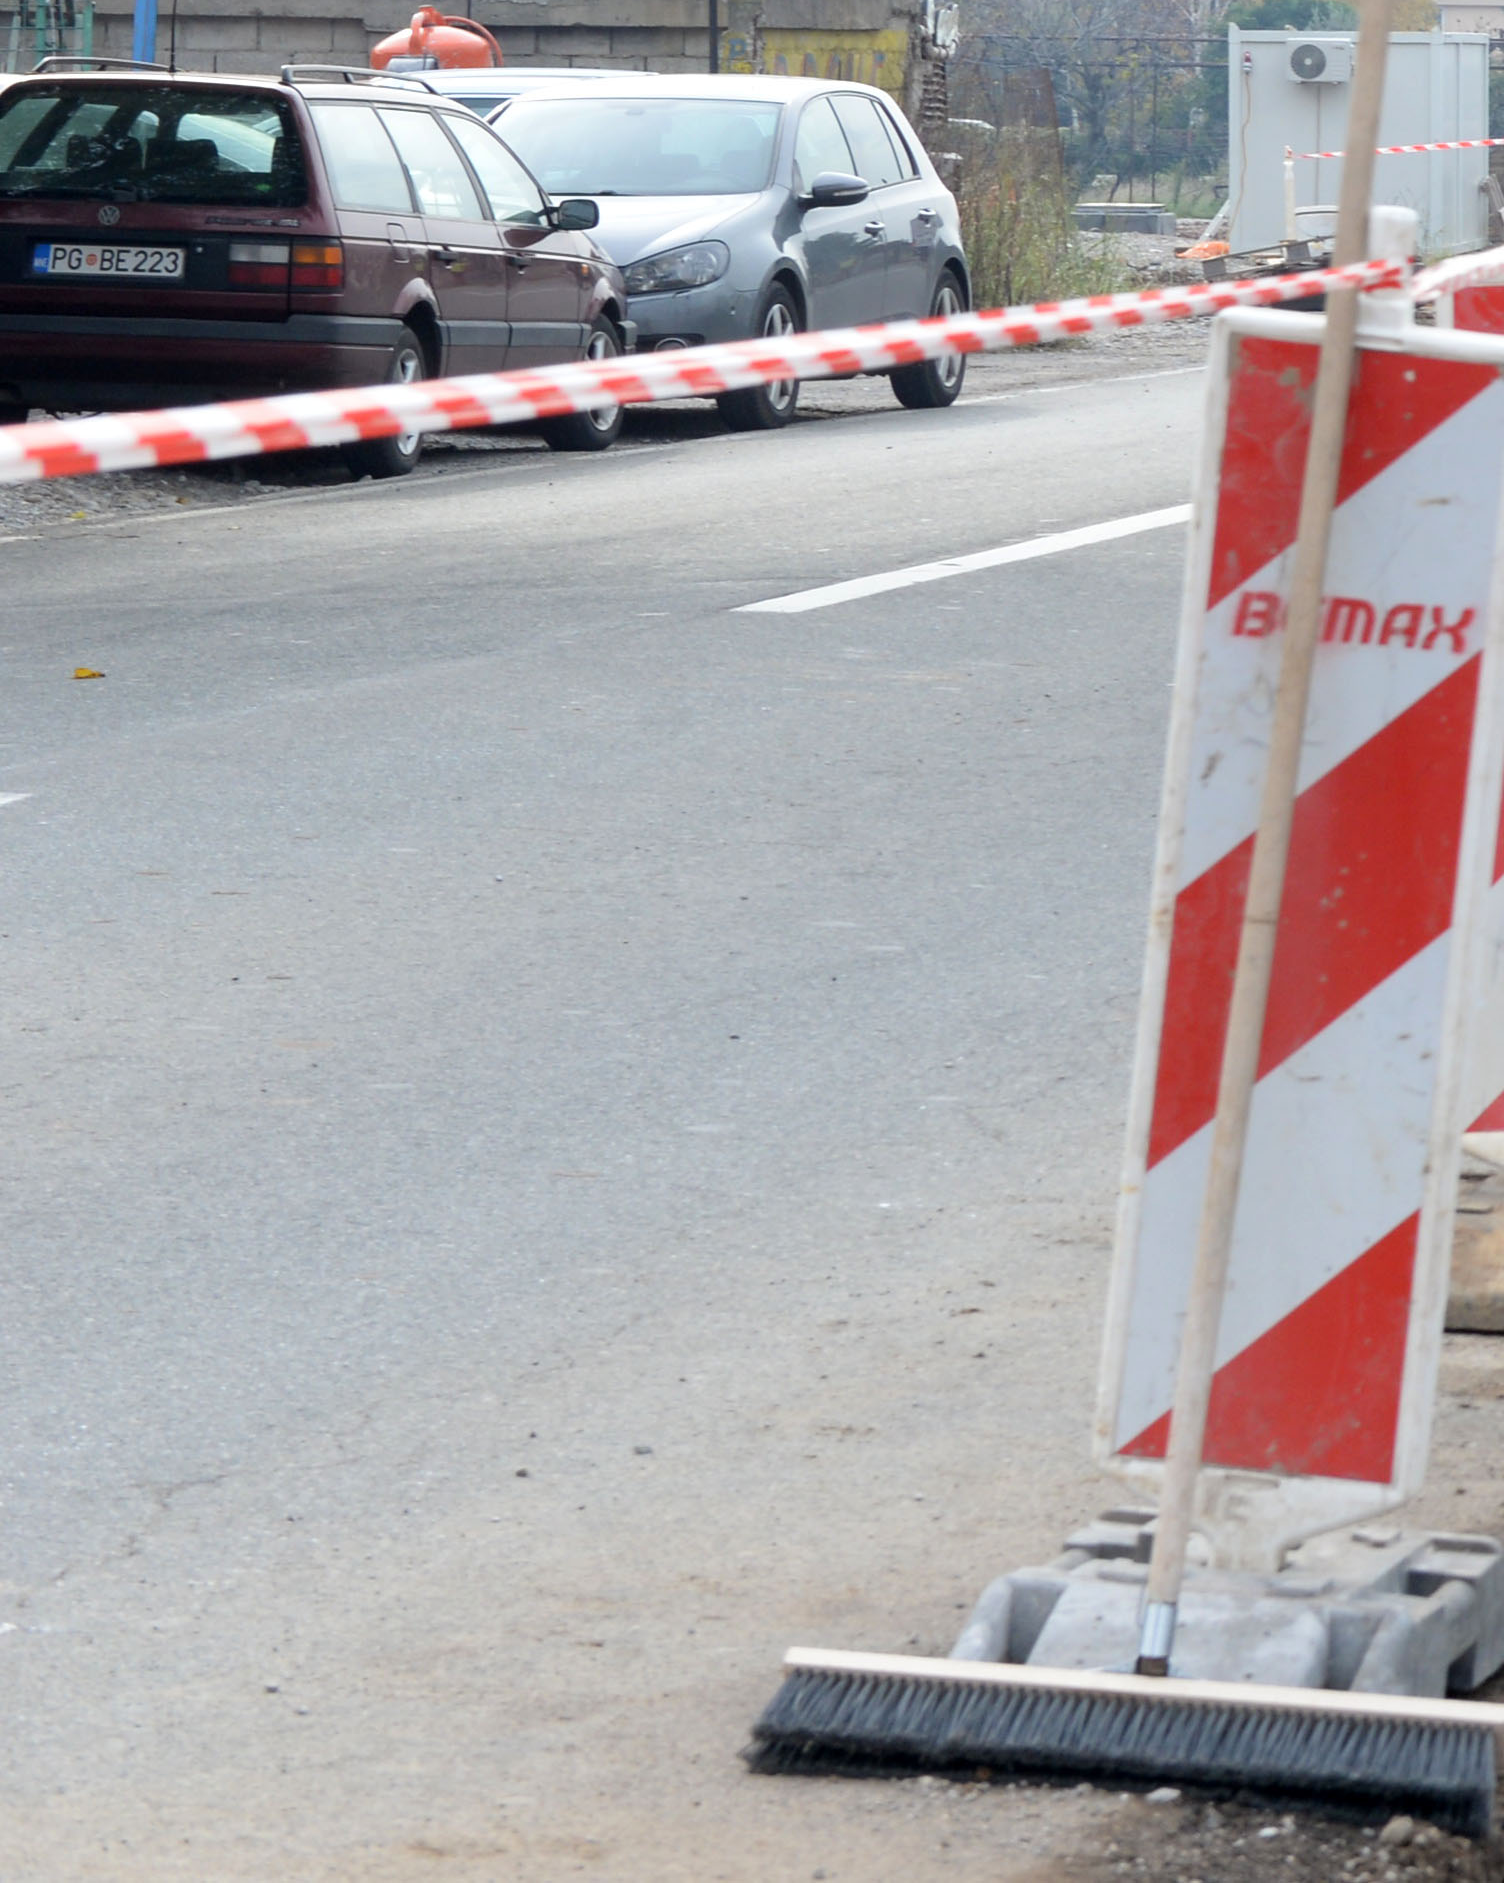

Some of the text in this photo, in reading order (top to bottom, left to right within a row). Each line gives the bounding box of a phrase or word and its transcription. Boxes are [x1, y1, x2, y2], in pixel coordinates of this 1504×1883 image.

[51, 247, 83, 270] PG
[100, 249, 180, 274] BE223
[1232, 590, 1478, 654] BMAX
